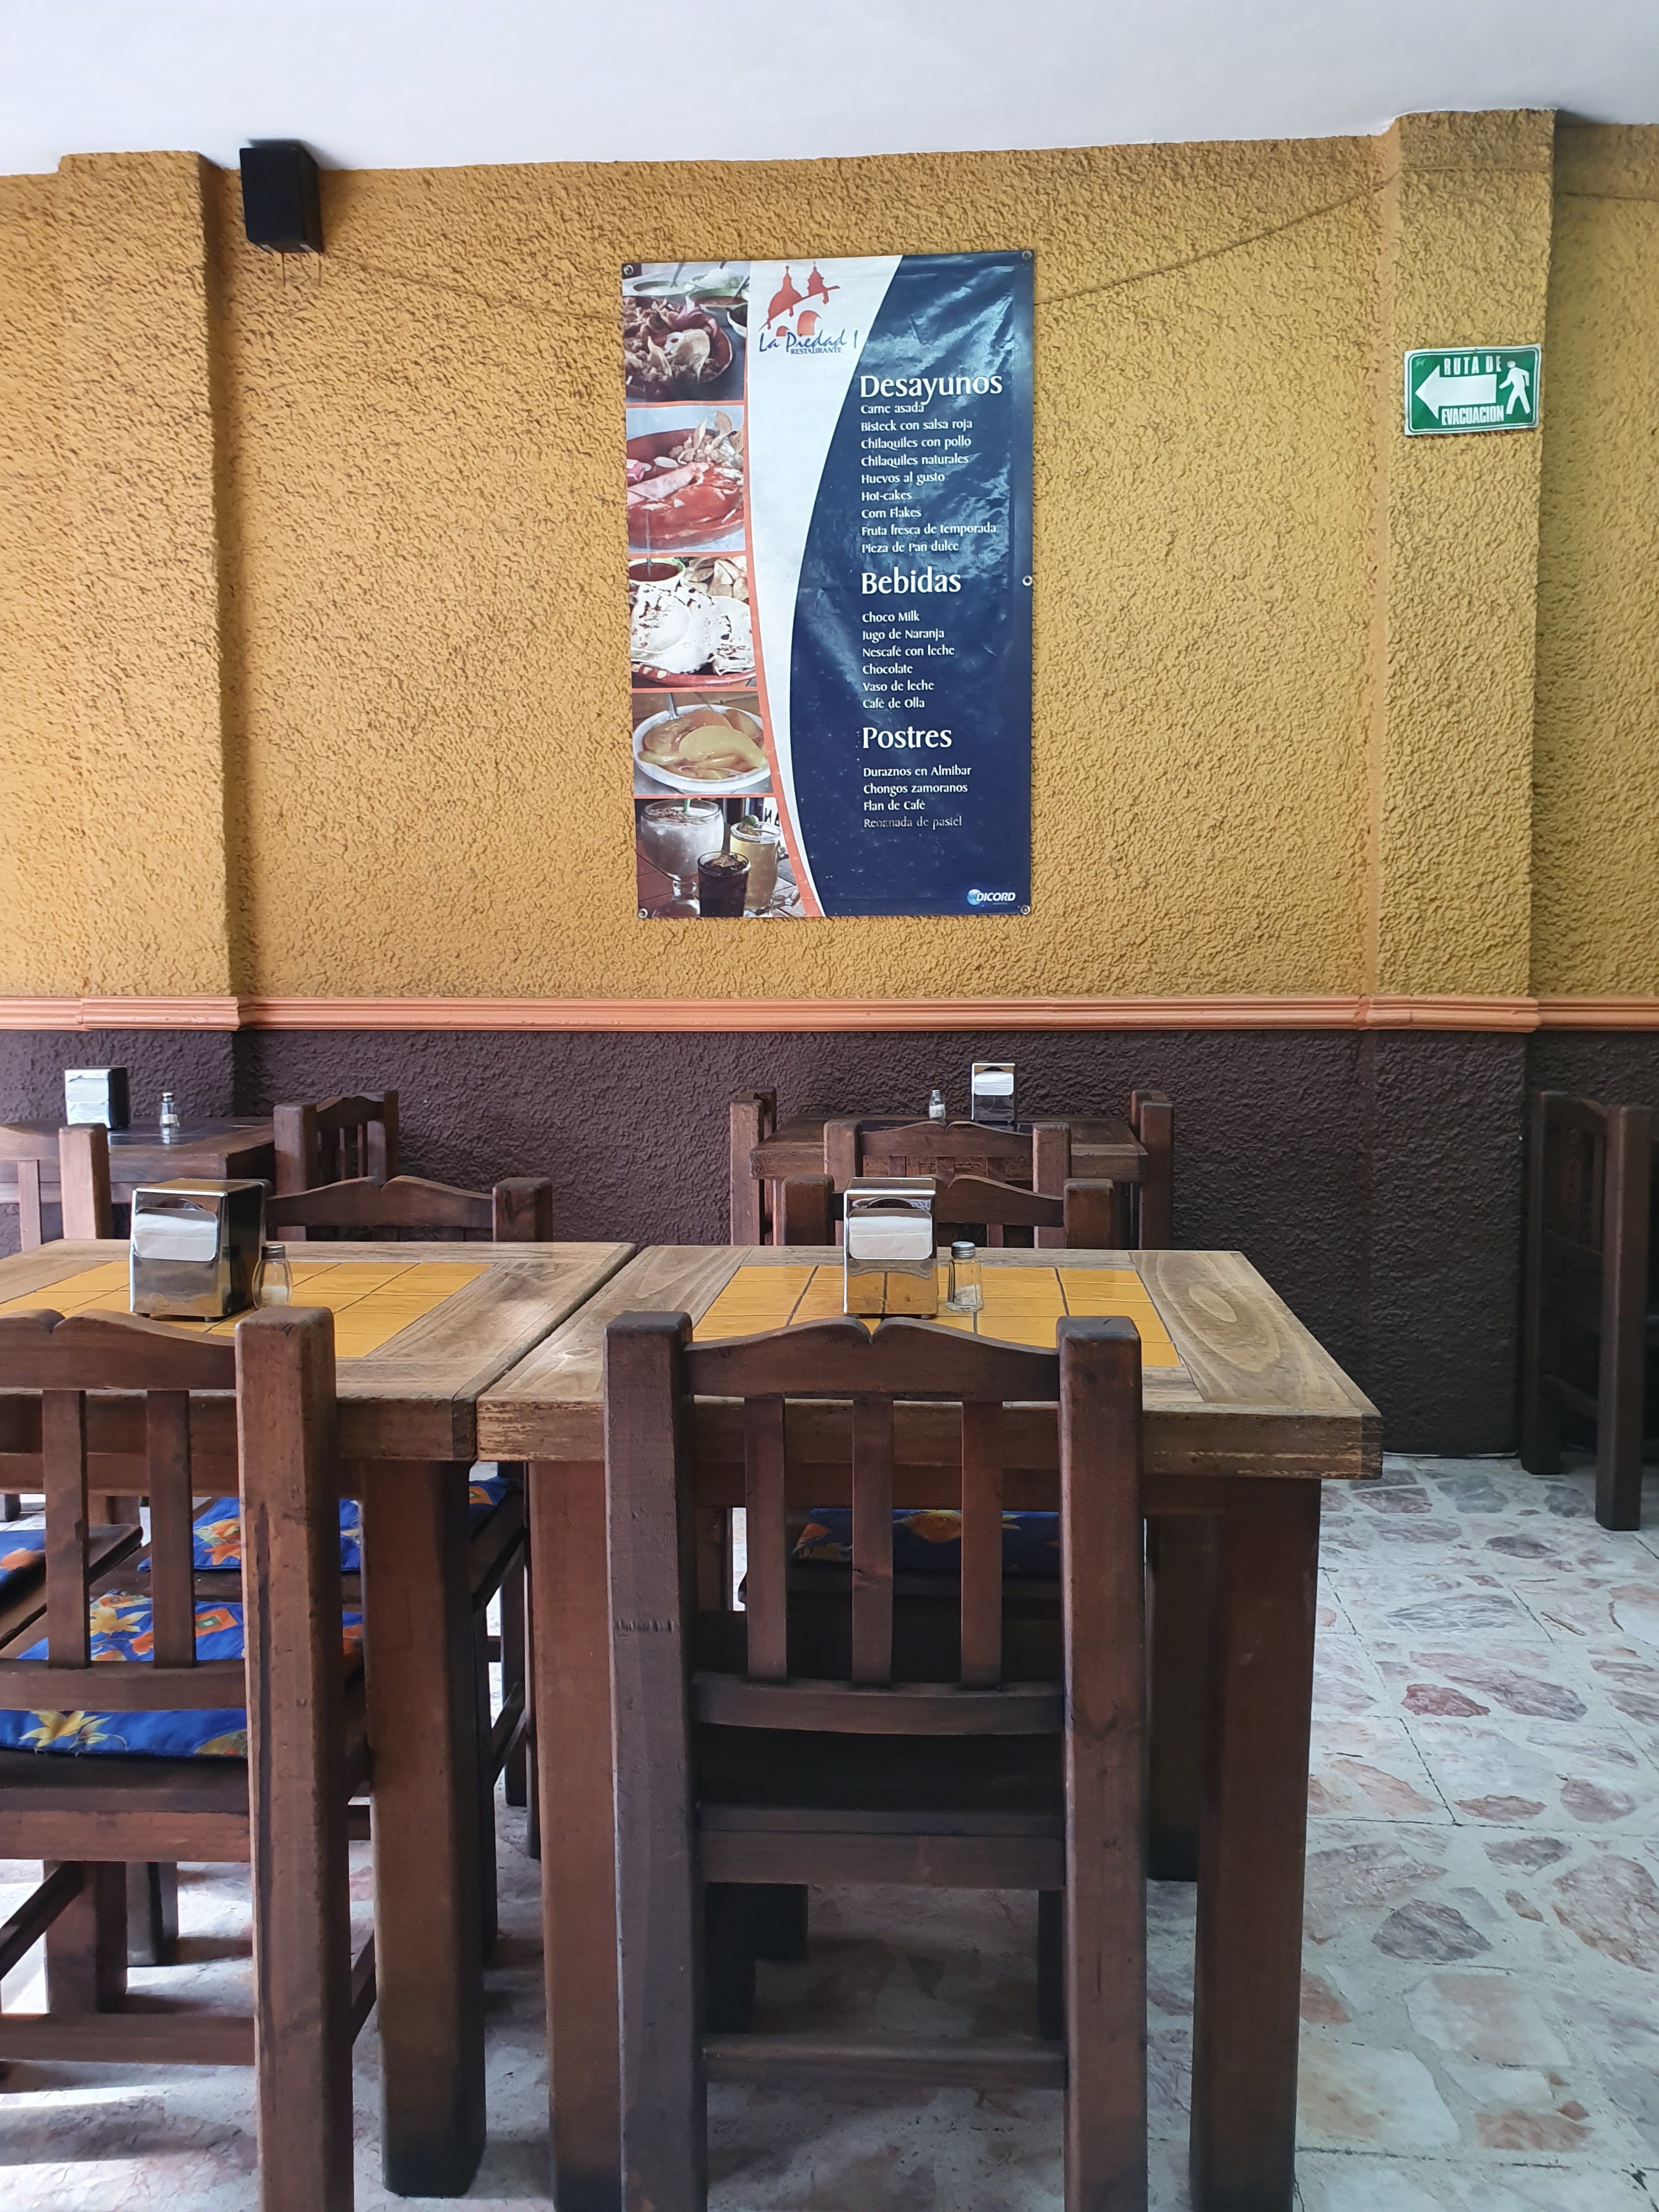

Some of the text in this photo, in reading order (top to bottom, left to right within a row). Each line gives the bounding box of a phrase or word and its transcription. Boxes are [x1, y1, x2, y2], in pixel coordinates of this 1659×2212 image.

[759, 332, 780, 352] La
[786, 329, 847, 352] Piedad
[1444, 356, 1502, 375] RUTA DE
[860, 375, 1003, 405] Desayunos
[861, 401, 924, 414] Carne asada
[1442, 405, 1504, 425] EVACUACION
[861, 418, 973, 432] Bisteck con salsa roja
[861, 435, 972, 450] Chilaquiles con pollo
[861, 453, 969, 468] Chilaquiles naturales
[861, 471, 945, 486] Huevos al gusto
[861, 489, 912, 501] Hot-cakes
[861, 506, 922, 518] Corn Flakes
[861, 521, 996, 537] Fruta fresca de temporada
[862, 540, 959, 553] Pieza de Pan dulce
[861, 566, 961, 595] Bebidas
[862, 610, 920, 623] Choco Milk
[862, 628, 945, 644] Jugo de Naranja
[905, 648, 924, 657] con
[928, 644, 955, 656] leche
[862, 663, 913, 674] Chocolate
[862, 679, 935, 691] Vaso de leche
[888, 697, 901, 709] de
[904, 696, 926, 708] Olla
[862, 726, 953, 749] Postres
[864, 768, 912, 777] Duraznos
[864, 783, 968, 797] Chongos zamoranos
[864, 800, 884, 811] Flan
[888, 799, 900, 810] de
[917, 816, 929, 827] de
[933, 815, 962, 830] pastel
[976, 892, 1016, 901] DICORD
